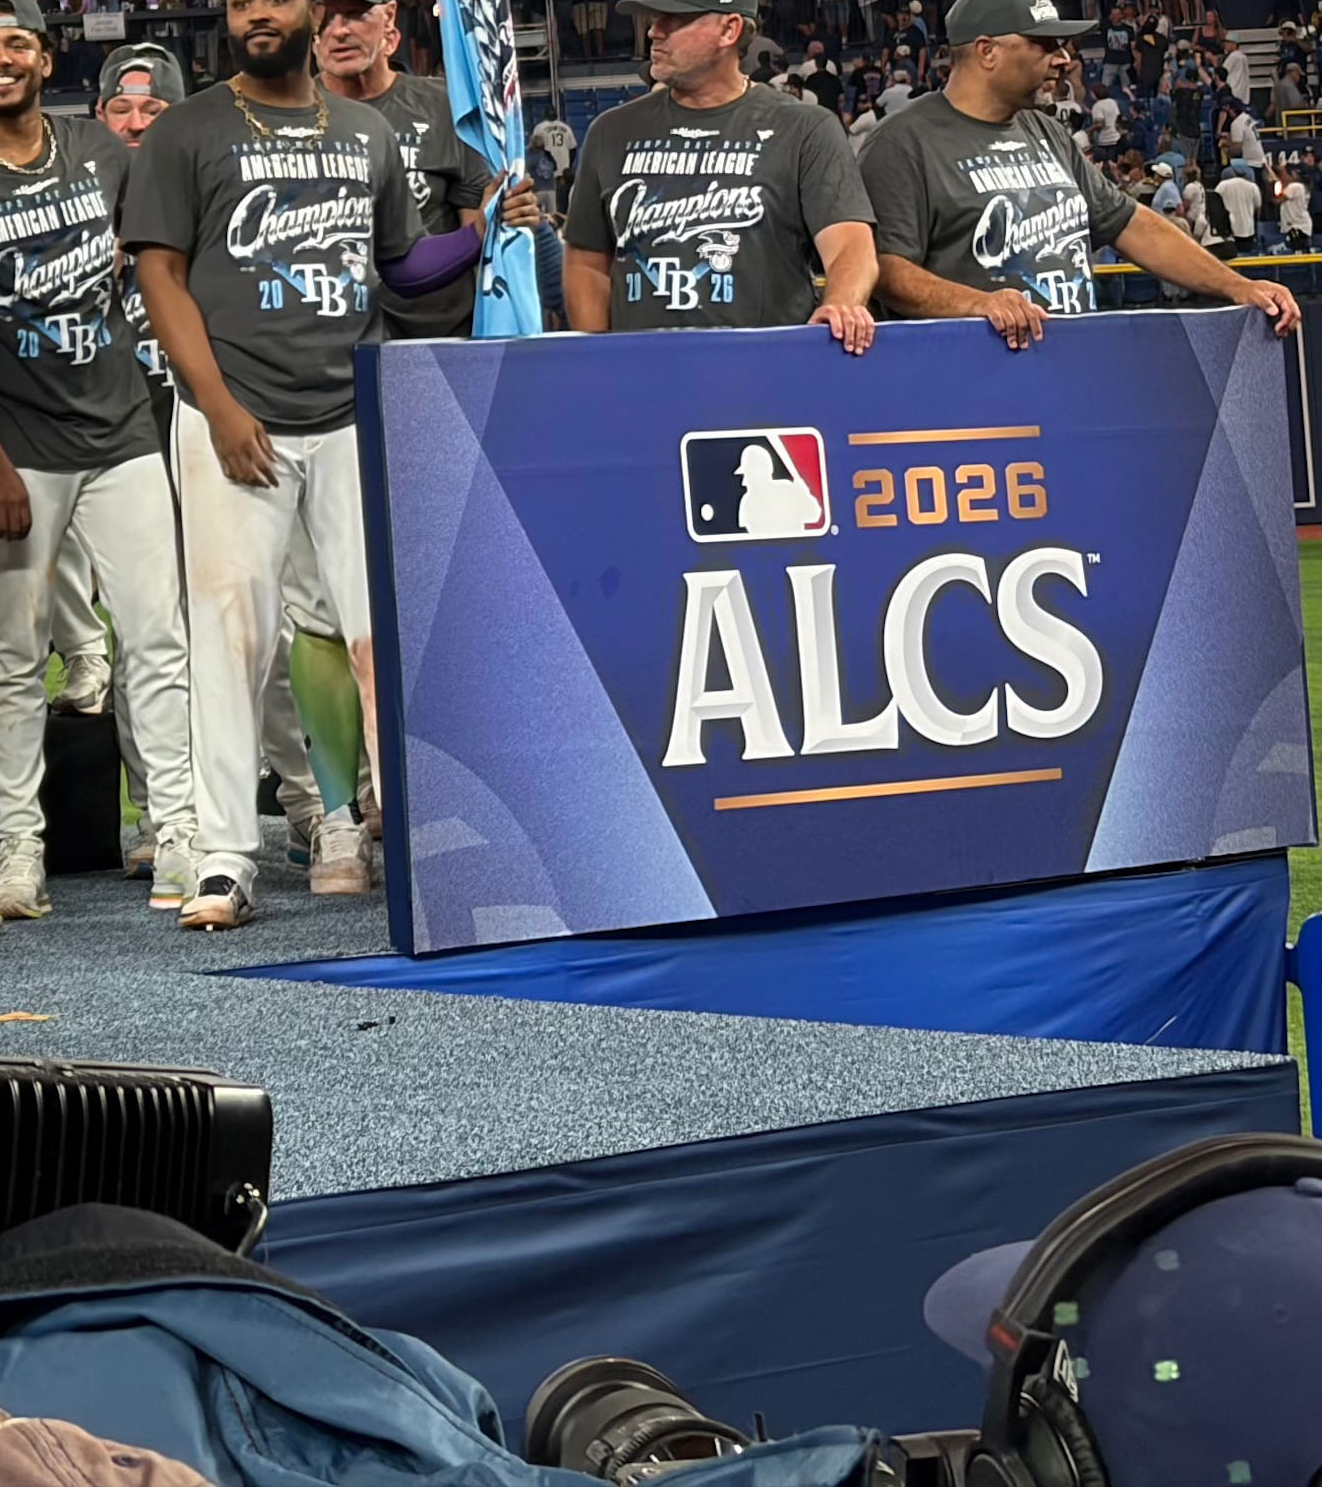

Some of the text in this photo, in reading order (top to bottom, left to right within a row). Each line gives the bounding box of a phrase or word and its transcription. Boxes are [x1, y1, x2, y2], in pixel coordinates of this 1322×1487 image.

[551, 132, 564, 148] 13
[621, 151, 760, 176] AMERICAN LEAGUE
[1265, 150, 1301, 166] 144
[239, 153, 319, 182] AMERICAN
[320, 153, 370, 184] LEAGUE
[60, 190, 108, 232] LEAGUE
[226, 184, 374, 259] Champion
[610, 178, 765, 248] Champions
[972, 189, 1090, 270] Champion
[259, 279, 284, 310] 20
[289, 263, 348, 317] TB
[647, 256, 700, 310] TB
[711, 273, 735, 303] 26
[17, 329, 40, 358] 20
[45, 313, 96, 366] TB
[852, 461, 1049, 529] 2026
[661, 547, 1104, 767] ALCS
